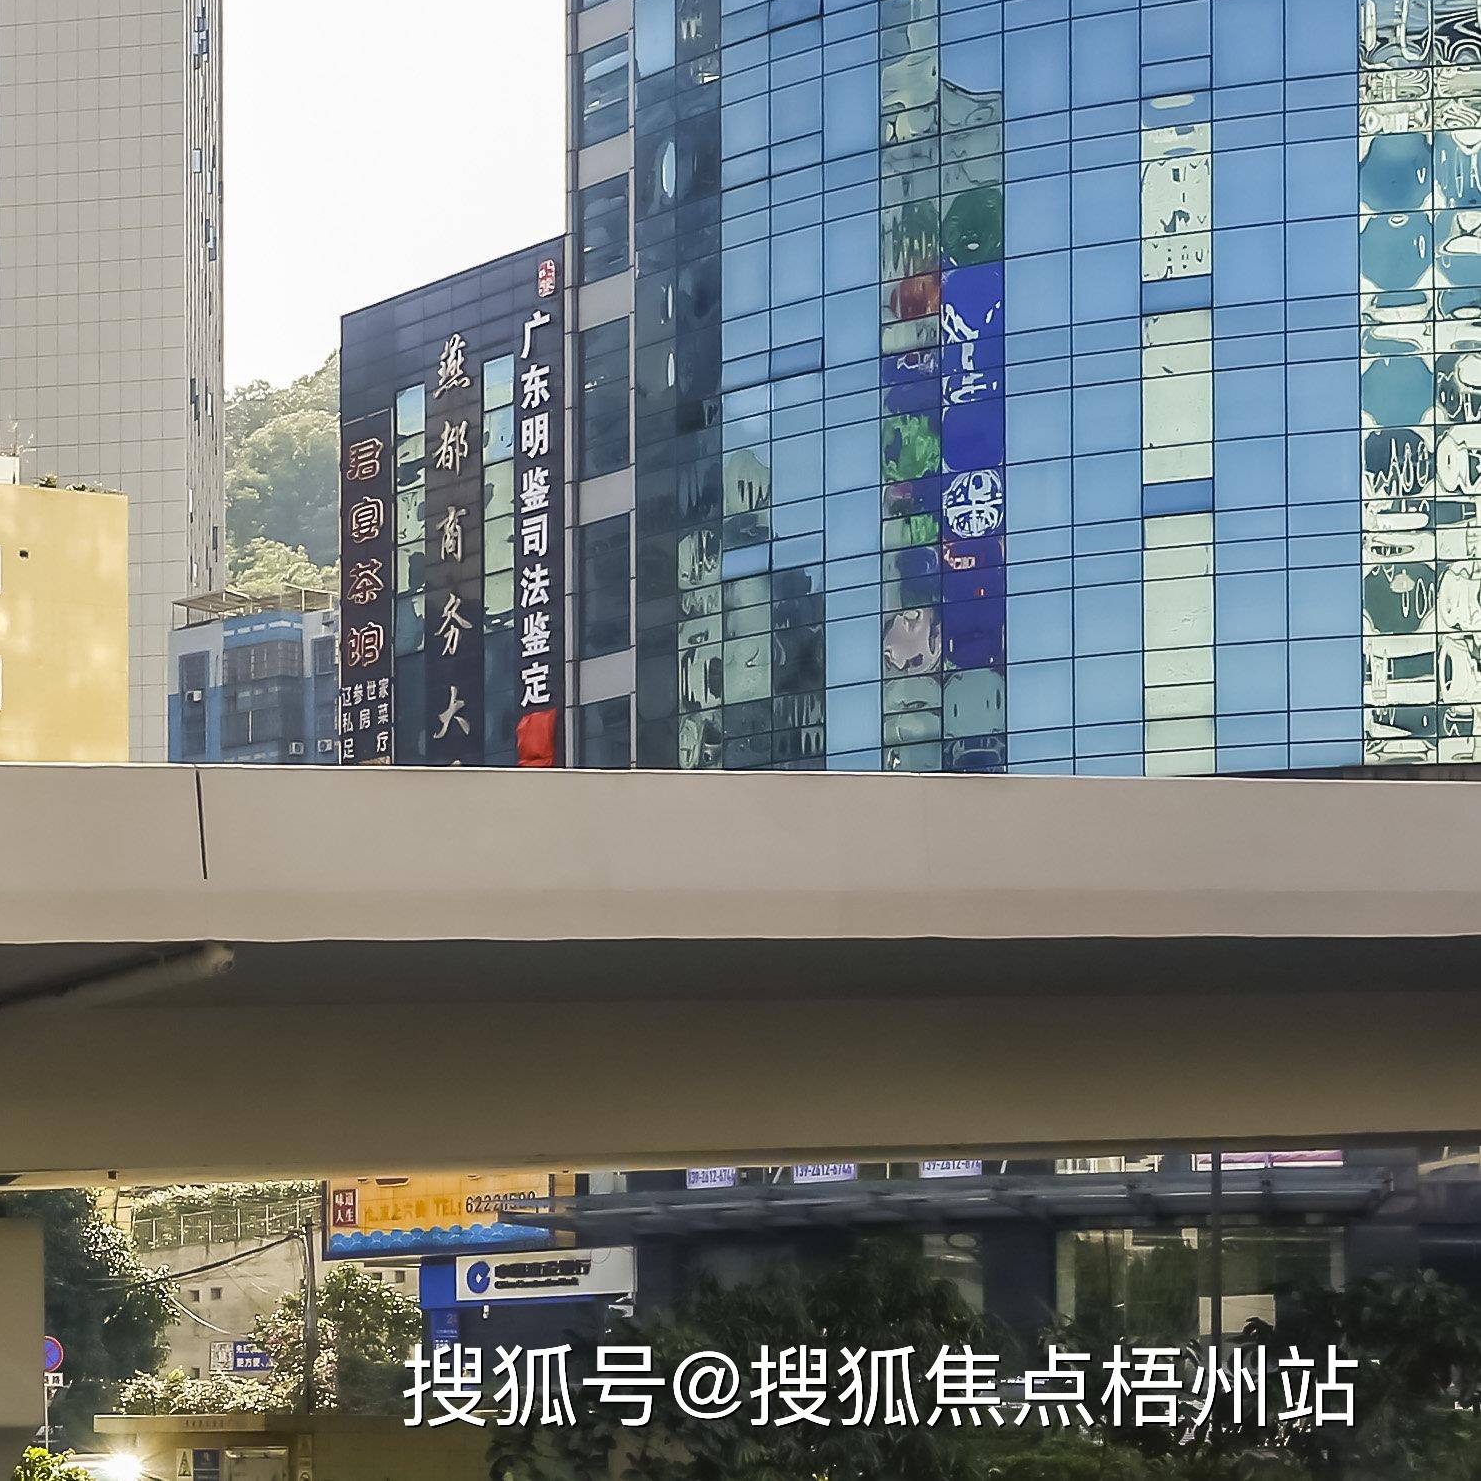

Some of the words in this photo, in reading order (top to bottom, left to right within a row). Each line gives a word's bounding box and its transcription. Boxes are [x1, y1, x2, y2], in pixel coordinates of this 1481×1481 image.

[434, 334, 472, 766] 燕都商务大
[520, 311, 551, 707] 广东明鉴司法鉴定
[342, 703, 389, 733] 私房菜
